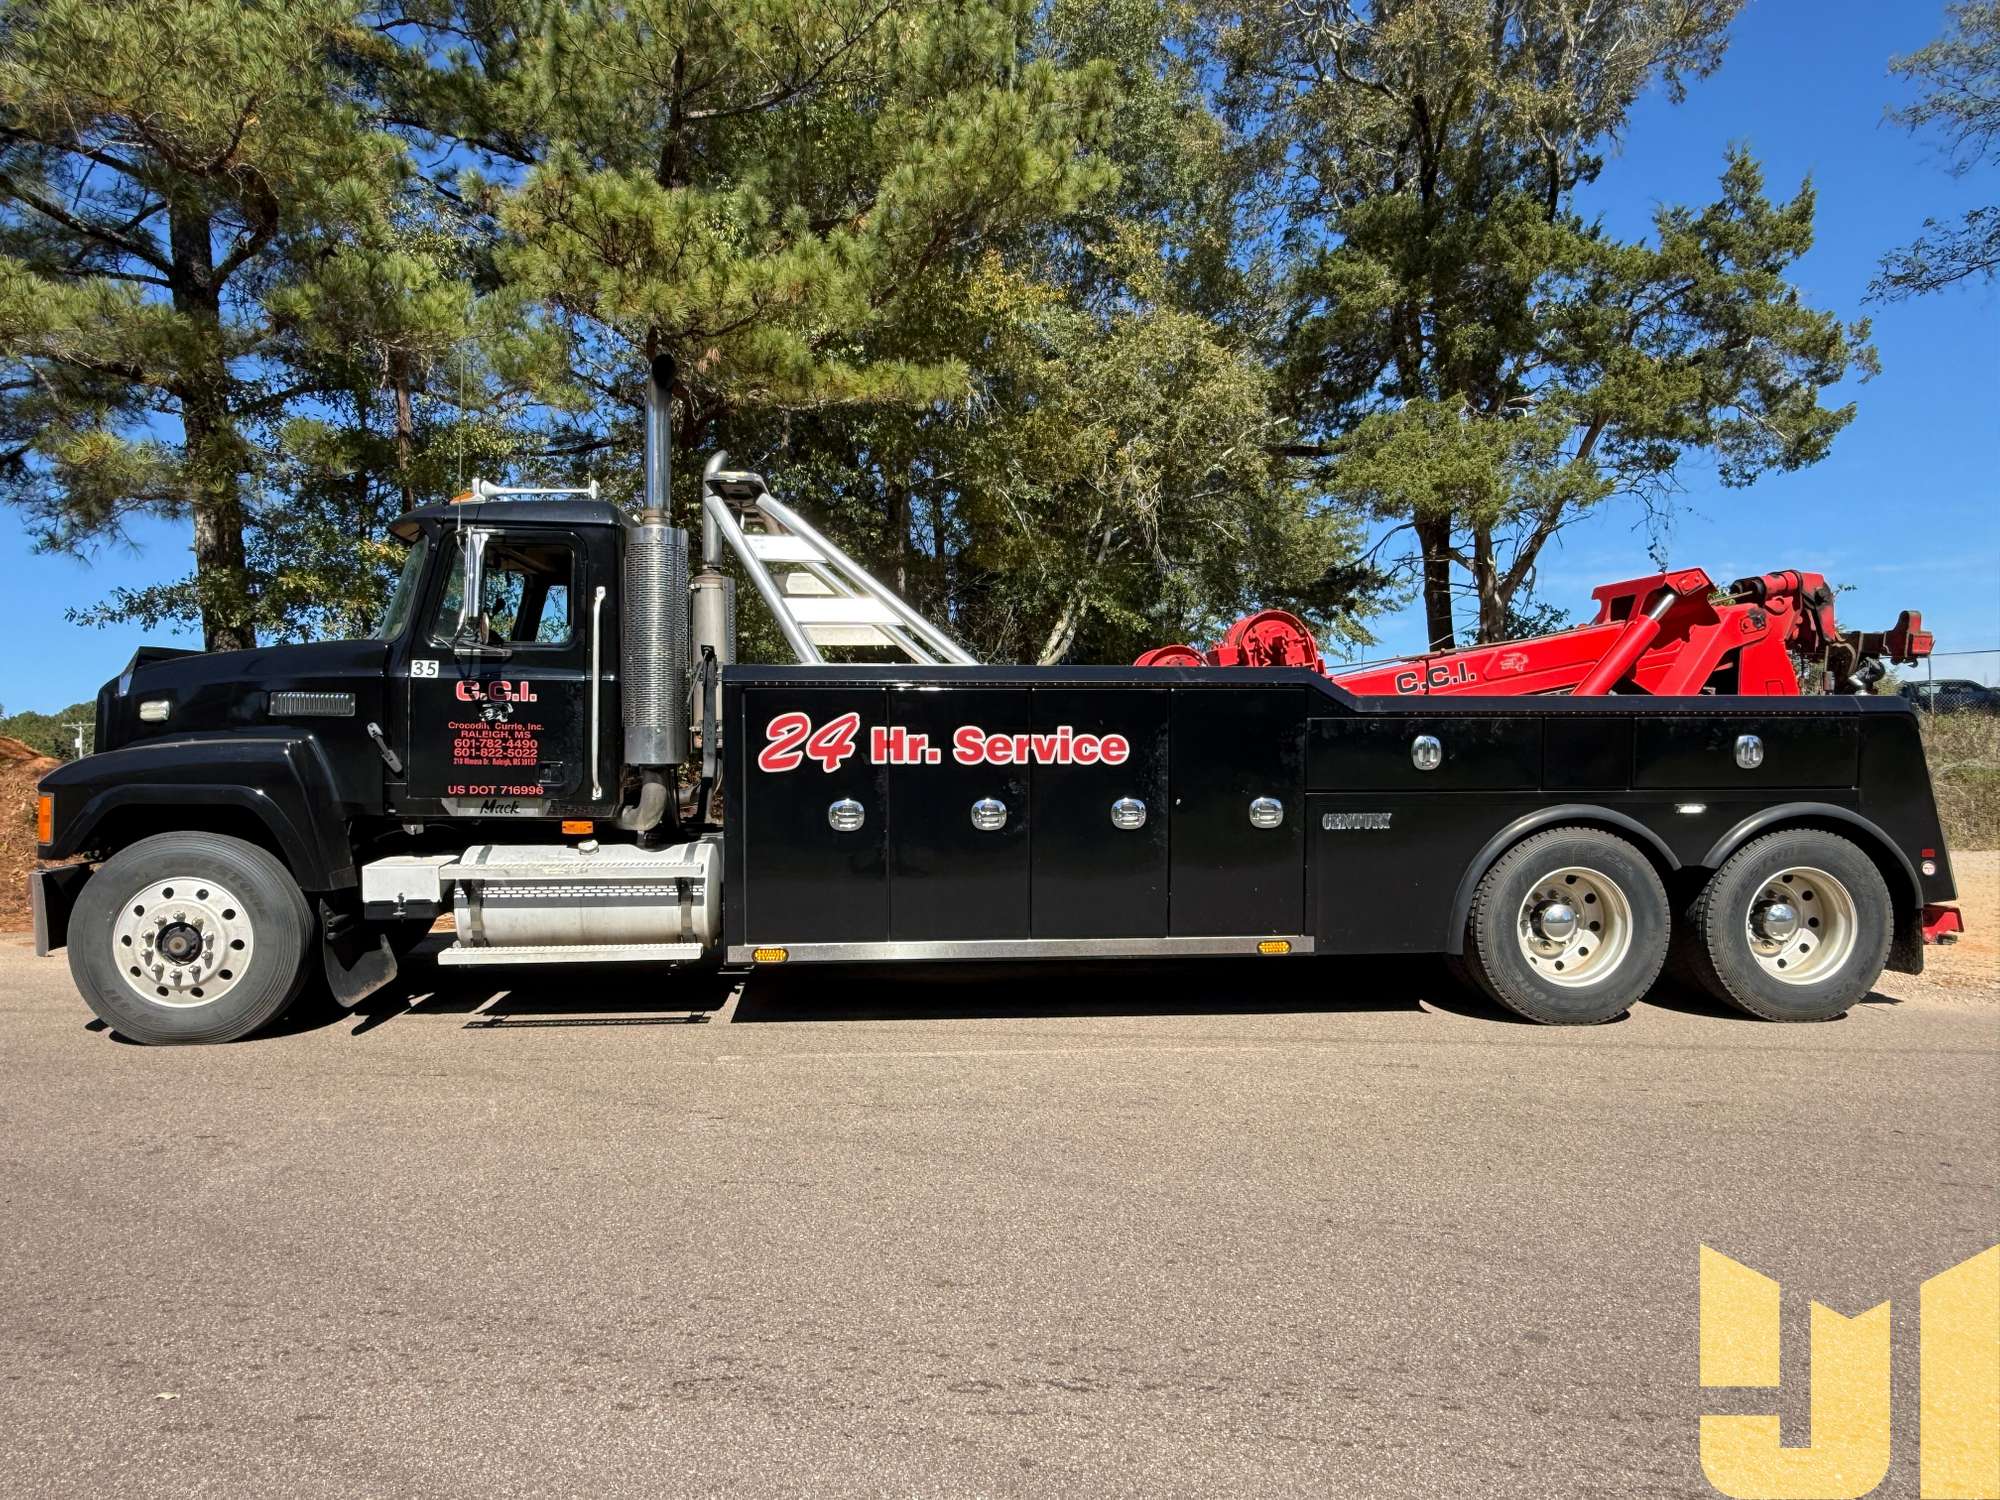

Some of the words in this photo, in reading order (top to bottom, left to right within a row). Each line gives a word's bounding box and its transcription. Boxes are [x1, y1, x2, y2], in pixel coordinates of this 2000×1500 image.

[413, 661, 437, 676] 35
[1395, 662, 1477, 695] C.C.I.
[455, 680, 538, 702] C.C.I.
[527, 723, 545, 731] Inc.
[461, 730, 511, 739] RALEIGH,
[454, 738, 538, 748] 601-782-4490
[758, 712, 860, 773] 24
[870, 726, 941, 765] Hr.
[953, 725, 1130, 765] Service
[454, 748, 538, 757] 601-822-5022
[448, 785, 466, 794] US
[469, 785, 496, 794] DOT
[500, 785, 544, 795] 716996
[480, 799, 519, 814] Mack
